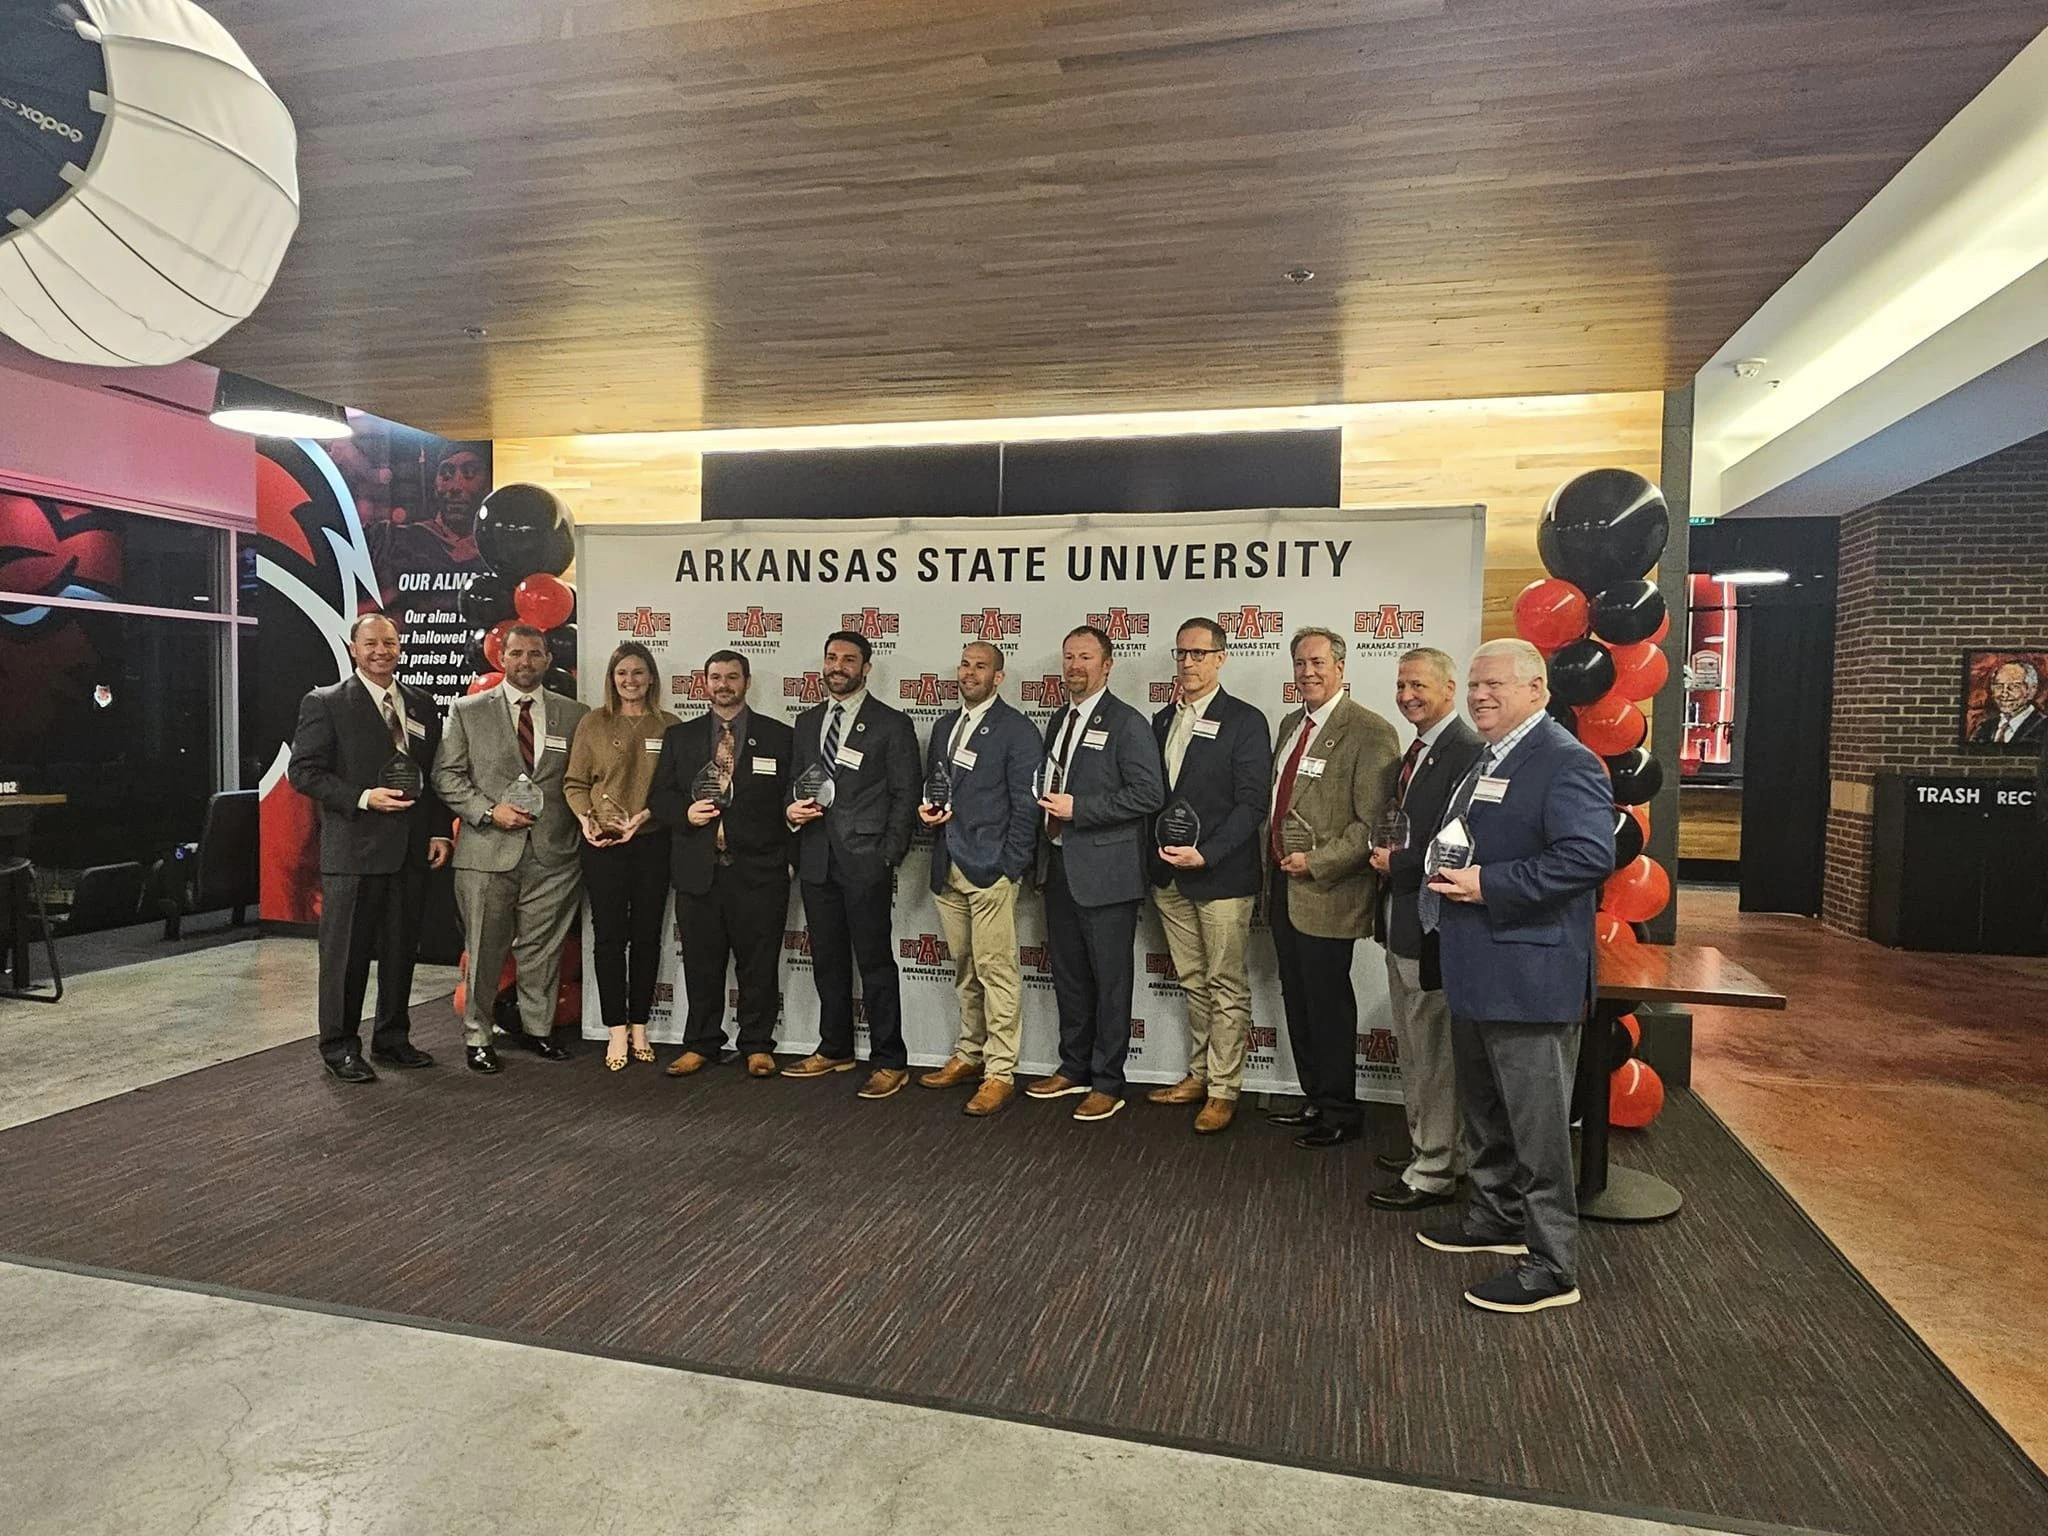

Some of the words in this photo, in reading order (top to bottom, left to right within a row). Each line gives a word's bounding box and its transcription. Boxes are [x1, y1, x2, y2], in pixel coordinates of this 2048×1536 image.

[675, 547, 898, 583] ARKANSAS
[917, 546, 1047, 583] STATE
[1067, 540, 1353, 582] UNIVERSITY
[399, 573, 431, 592] OUR
[405, 609, 426, 624] Our
[428, 609, 456, 624] alma
[617, 606, 671, 637] STATE
[727, 606, 783, 638] STATE
[842, 607, 899, 639] STATE
[961, 608, 1022, 640] STATE
[1087, 607, 1149, 640] STATE
[1218, 605, 1283, 639] STATE
[1355, 605, 1424, 639] STATE
[412, 630, 467, 645] hallowed
[652, 640, 669, 648] STATE
[763, 641, 780, 649] STATE
[878, 642, 897, 650] STATE
[1226, 642, 1258, 650] KANSAS
[1356, 642, 1396, 650] ARKANSAS
[1000, 643, 1019, 651] STATE
[1126, 643, 1147, 651] STATE
[409, 651, 447, 667] praise
[449, 651, 464, 667] by
[402, 671, 434, 685] noble
[436, 674, 458, 685] son
[672, 670, 712, 700] STA
[900, 673, 959, 706] STATE
[1022, 675, 1070, 708] STAT
[1917, 787, 1981, 804] TRASH
[1997, 791, 2036, 805] REC
[902, 966, 936, 975] ARKANSAS
[937, 968, 956, 977] STATE
[906, 975, 952, 983] UNIVERSITY
